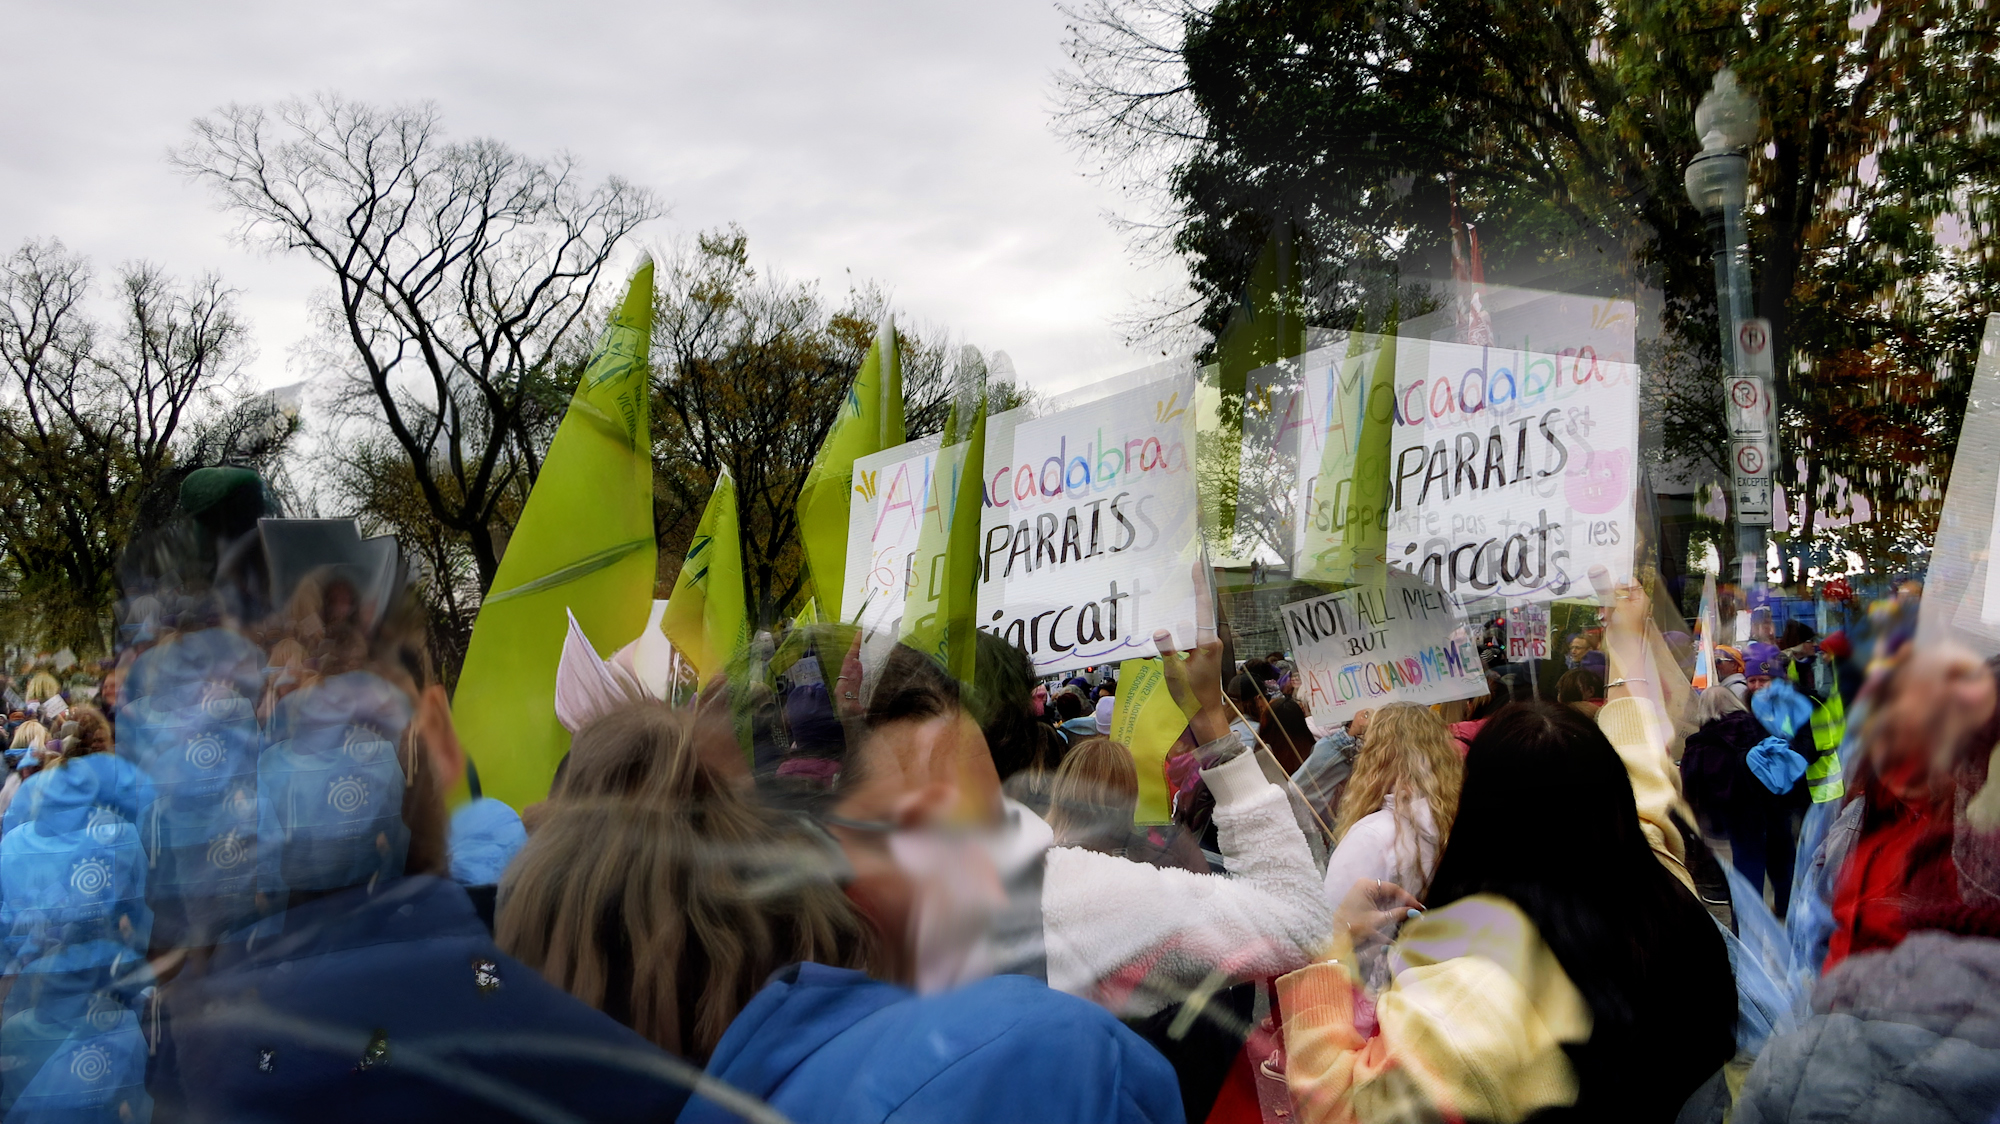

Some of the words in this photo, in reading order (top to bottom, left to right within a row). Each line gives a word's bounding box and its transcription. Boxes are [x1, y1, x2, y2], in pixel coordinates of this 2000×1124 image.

[1288, 596, 1347, 646] NOT
[1357, 588, 1396, 631] ALL
[1402, 587, 1462, 620] MEN
[1347, 629, 1390, 656] BUT
[1309, 670, 1329, 707] A
[1327, 664, 1362, 704] LOT
[1365, 657, 1423, 695] QUAND
[1419, 640, 1479, 682] MÊME
